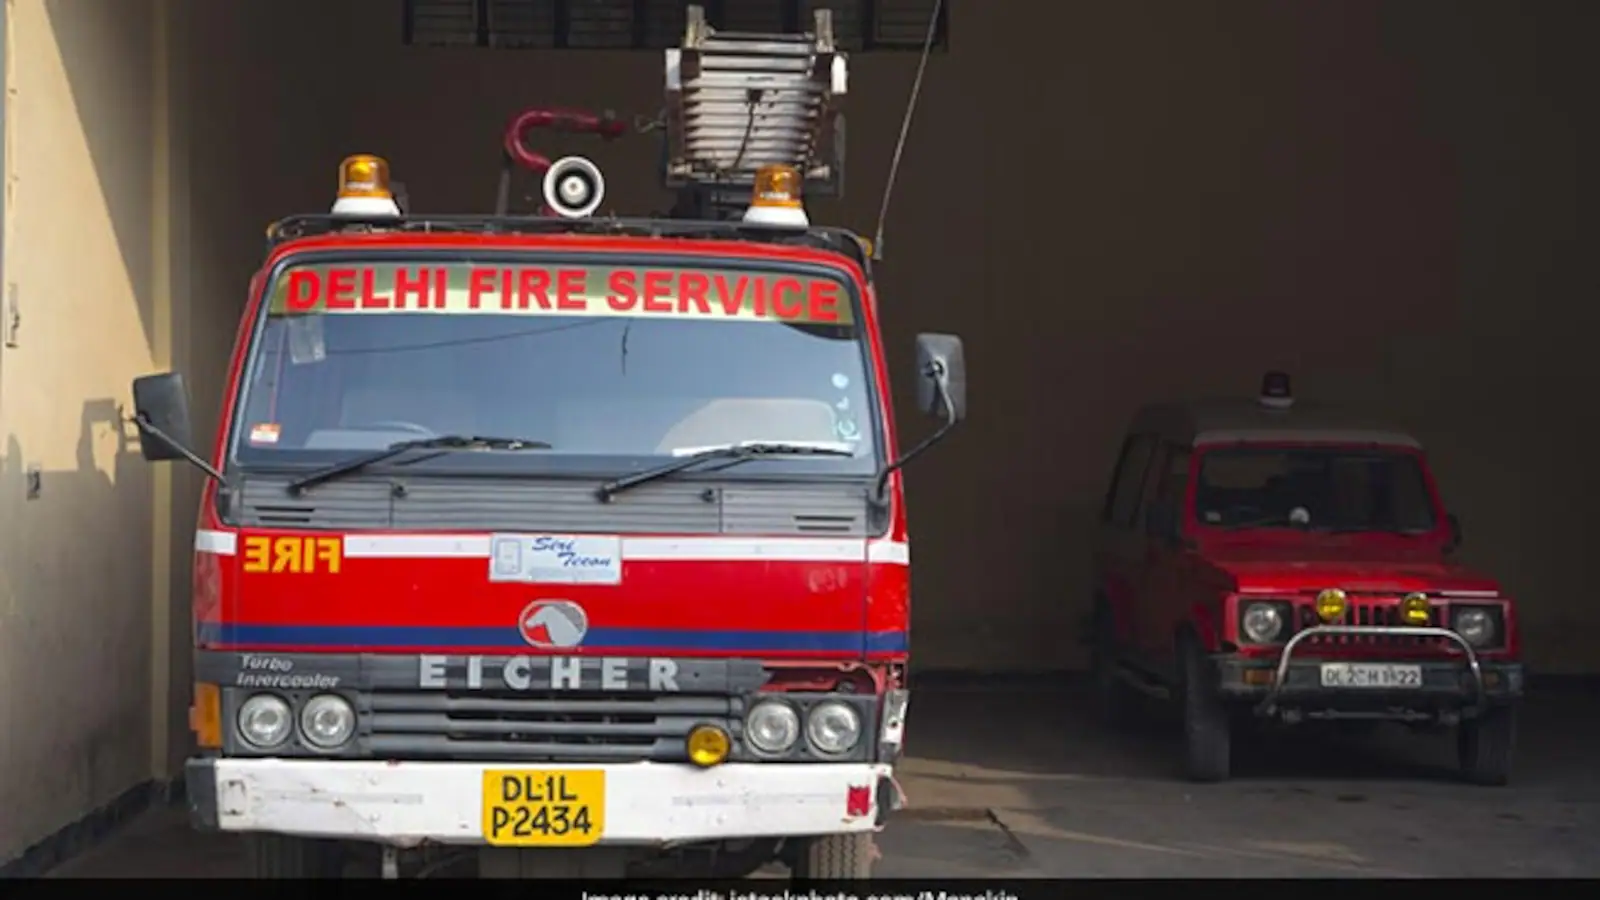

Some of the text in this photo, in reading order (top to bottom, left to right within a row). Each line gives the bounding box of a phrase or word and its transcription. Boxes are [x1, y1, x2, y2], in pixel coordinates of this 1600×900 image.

[285, 266, 841, 322] DELHI FIRE SERVICE
[241, 653, 294, 672] Turbo
[419, 653, 679, 692] EICHER
[235, 671, 341, 689] Intercooler
